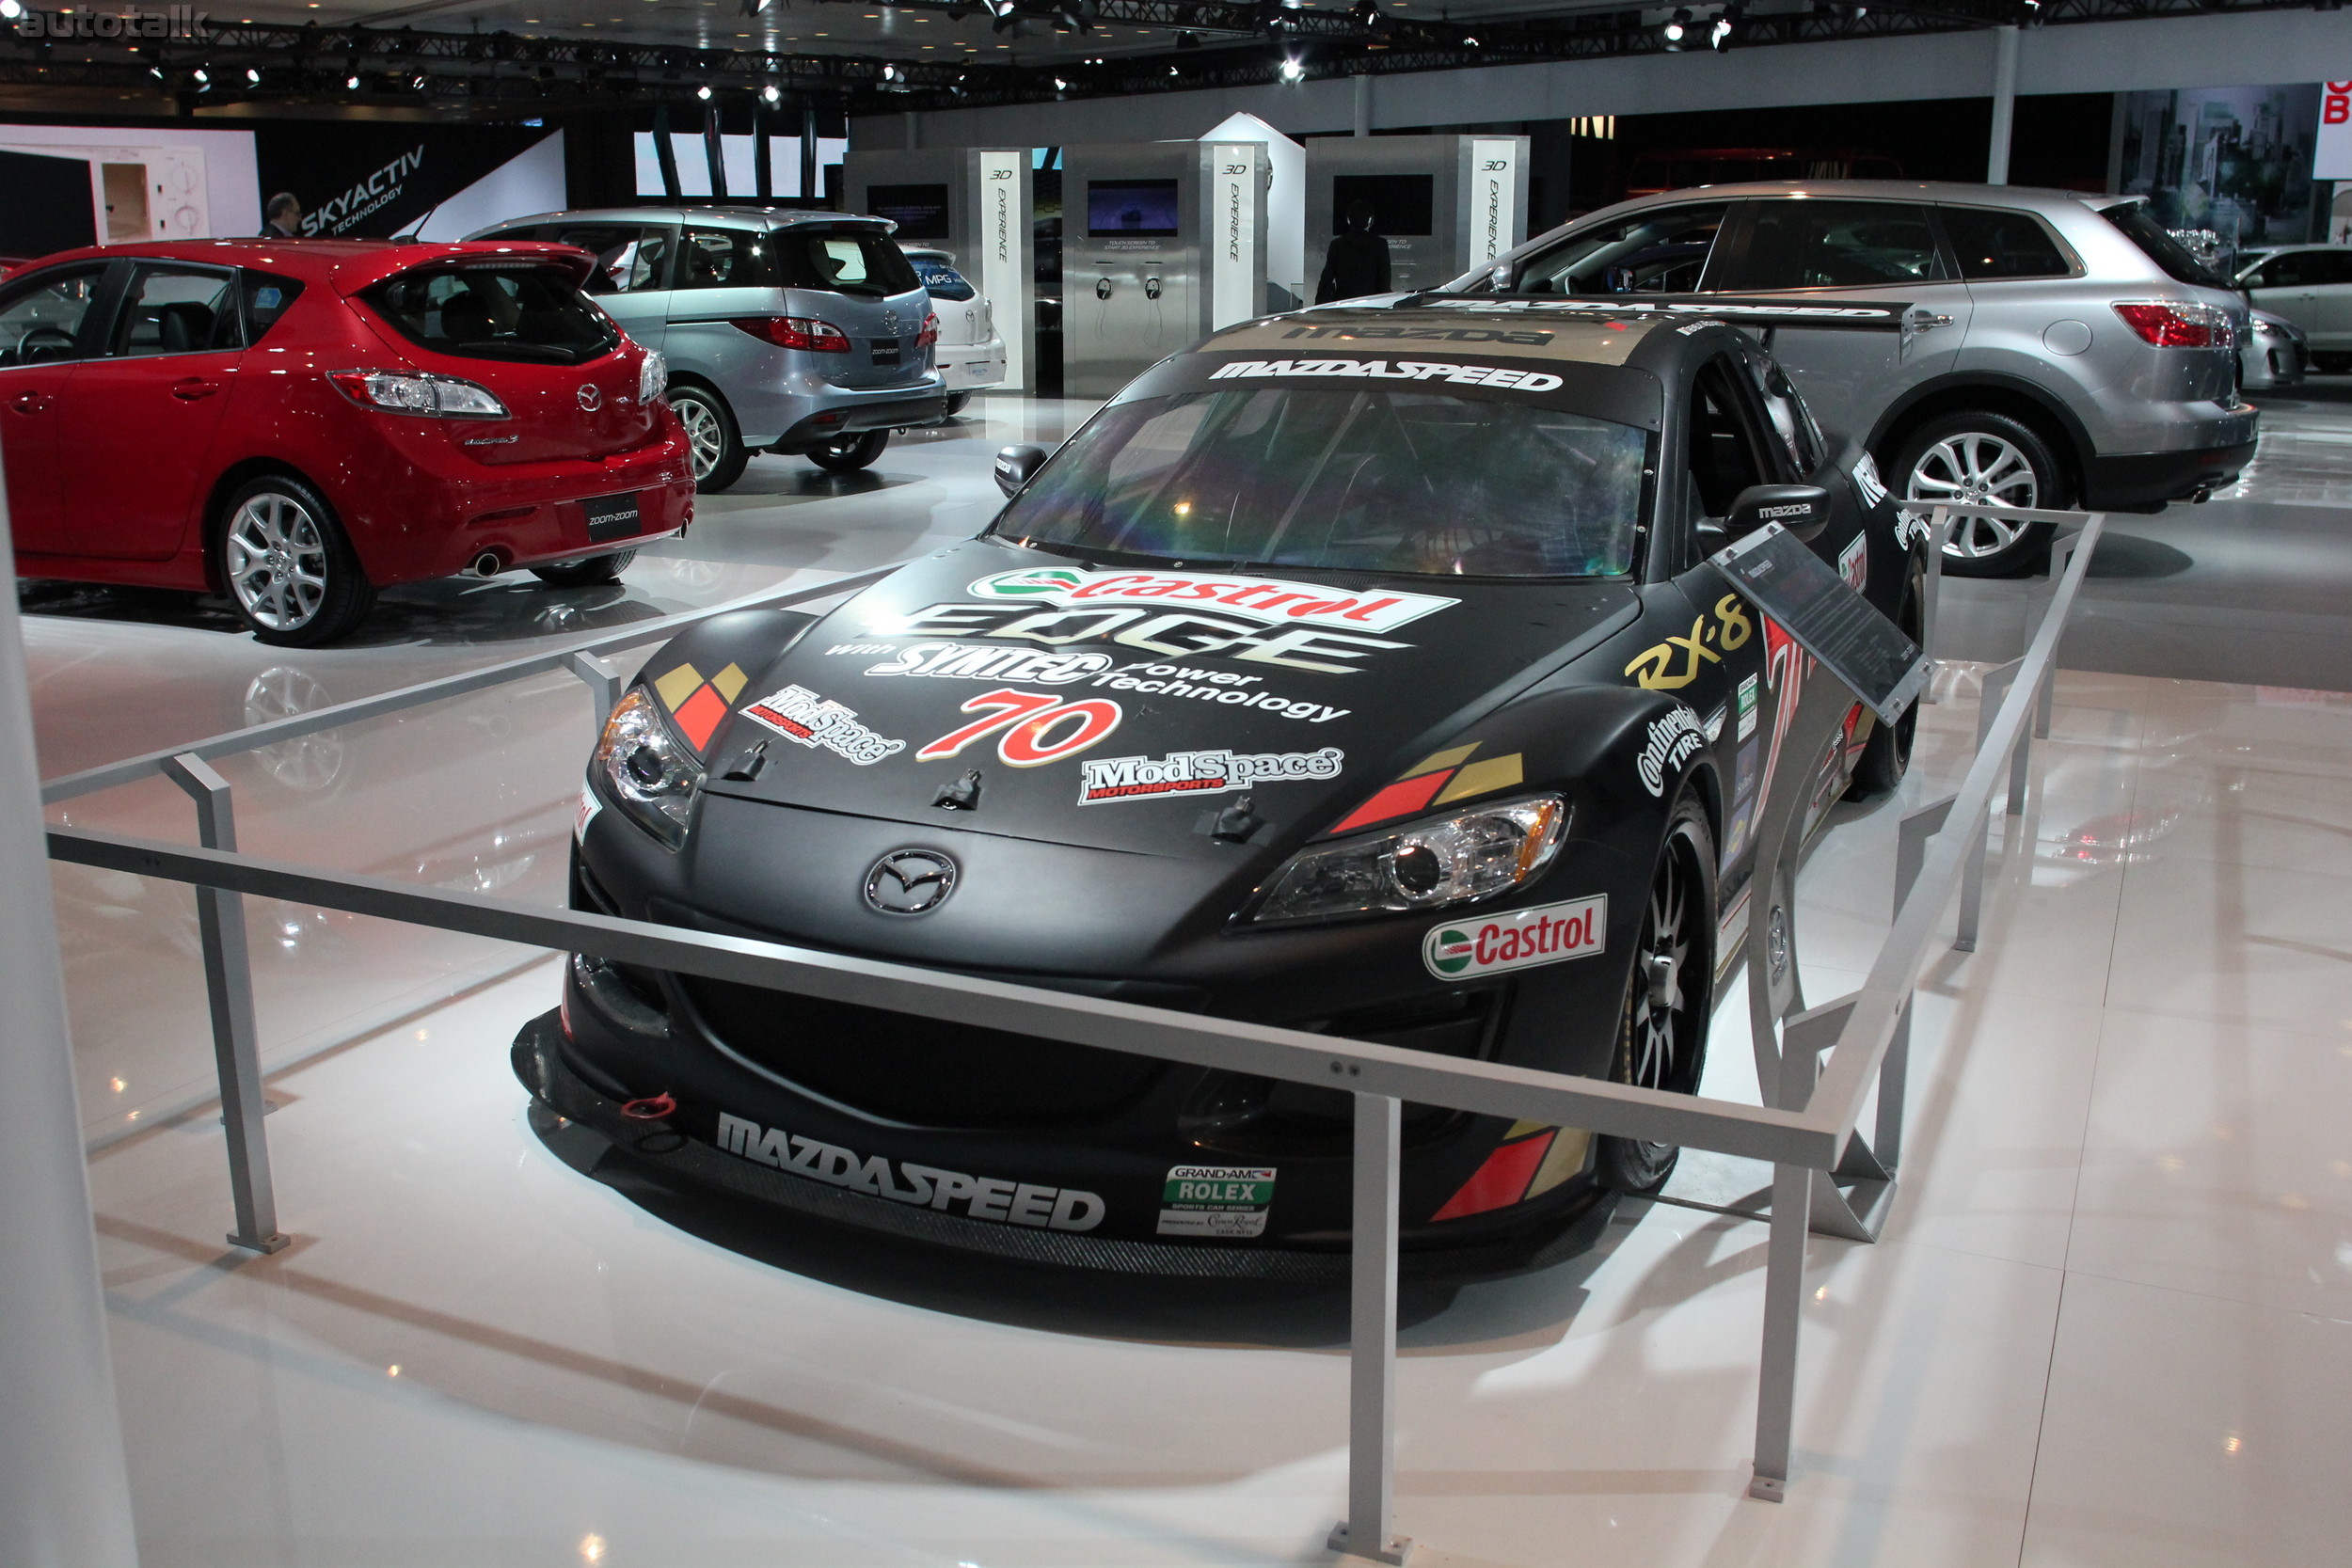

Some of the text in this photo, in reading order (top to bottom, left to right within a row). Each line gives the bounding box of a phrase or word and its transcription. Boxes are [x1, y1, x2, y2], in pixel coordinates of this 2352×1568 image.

[990, 169, 1012, 180] 3D
[1222, 165, 1247, 174] 3D
[1482, 161, 1506, 170] 3D
[301, 143, 424, 237] SKYACTIV
[331, 183, 403, 236] TECHNOLOGY
[998, 187, 1008, 263] EXPERIENCE
[1230, 182, 1239, 262] EXPERIENCE
[1487, 179, 1499, 261] EXPERIENCE
[925, 274, 952, 285] MPG
[1280, 325, 1556, 346] mazda
[1208, 358, 1564, 392] MAZDASPEED
[589, 509, 638, 526] zoom-zoom
[1759, 503, 1812, 518] mazda
[1071, 575, 1405, 622] Castrol
[858, 602, 1417, 674] EDGE
[1625, 593, 1752, 689] RX-8
[825, 643, 898, 656] with
[864, 641, 1113, 685] SYNTEC
[1090, 673, 1352, 723] Technology
[758, 688, 888, 761] ModSpace
[915, 688, 1122, 768] 70
[1089, 753, 1336, 790] ModSpace
[1668, 733, 1703, 772] TIRE
[1088, 778, 1226, 800] MOTORSPORTS
[1475, 908, 1595, 965] Castrol
[717, 1111, 1105, 1231] MAZDASPEED
[1179, 1181, 1256, 1200] ROLEX
